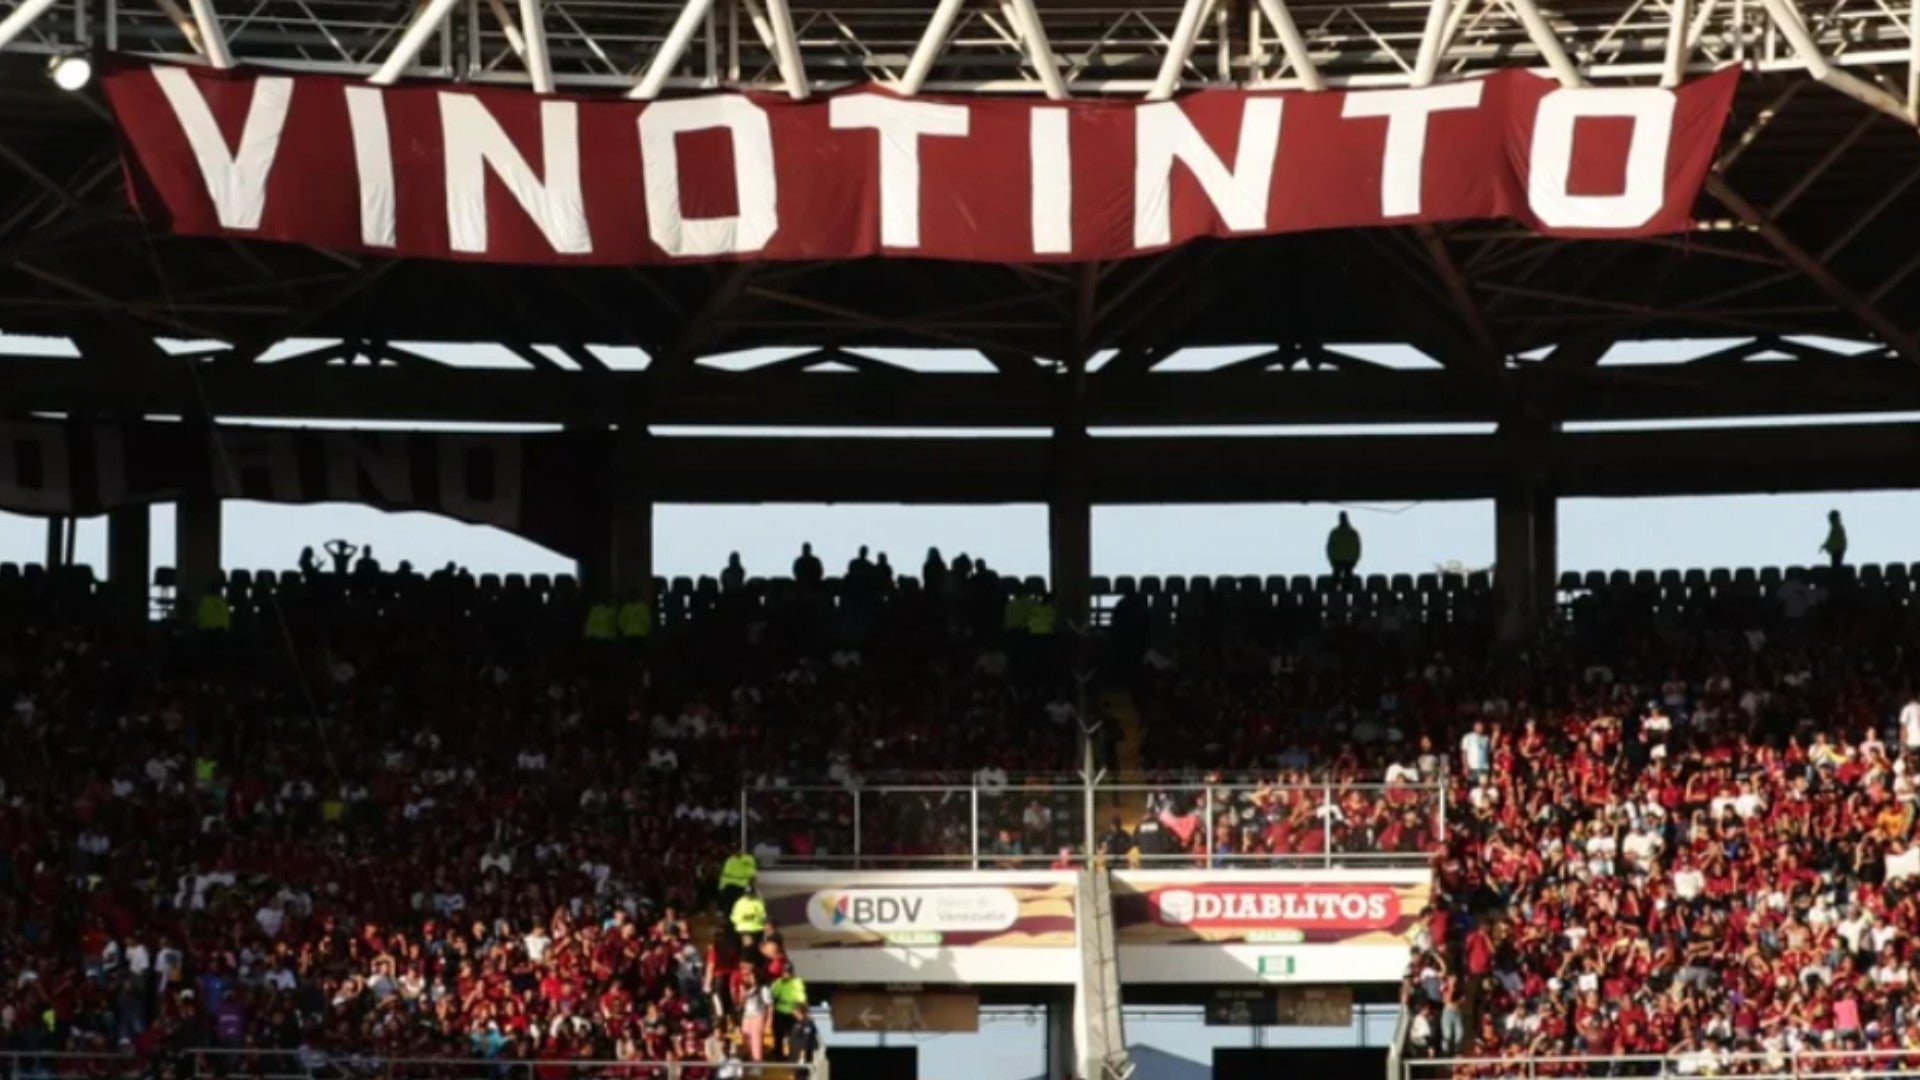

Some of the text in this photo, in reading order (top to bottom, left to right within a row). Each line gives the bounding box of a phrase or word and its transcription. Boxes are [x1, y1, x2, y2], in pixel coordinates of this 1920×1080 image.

[151, 64, 1676, 257] VINOTINTO
[853, 897, 923, 923] BDV
[1196, 893, 1387, 920] DIABLITOS
